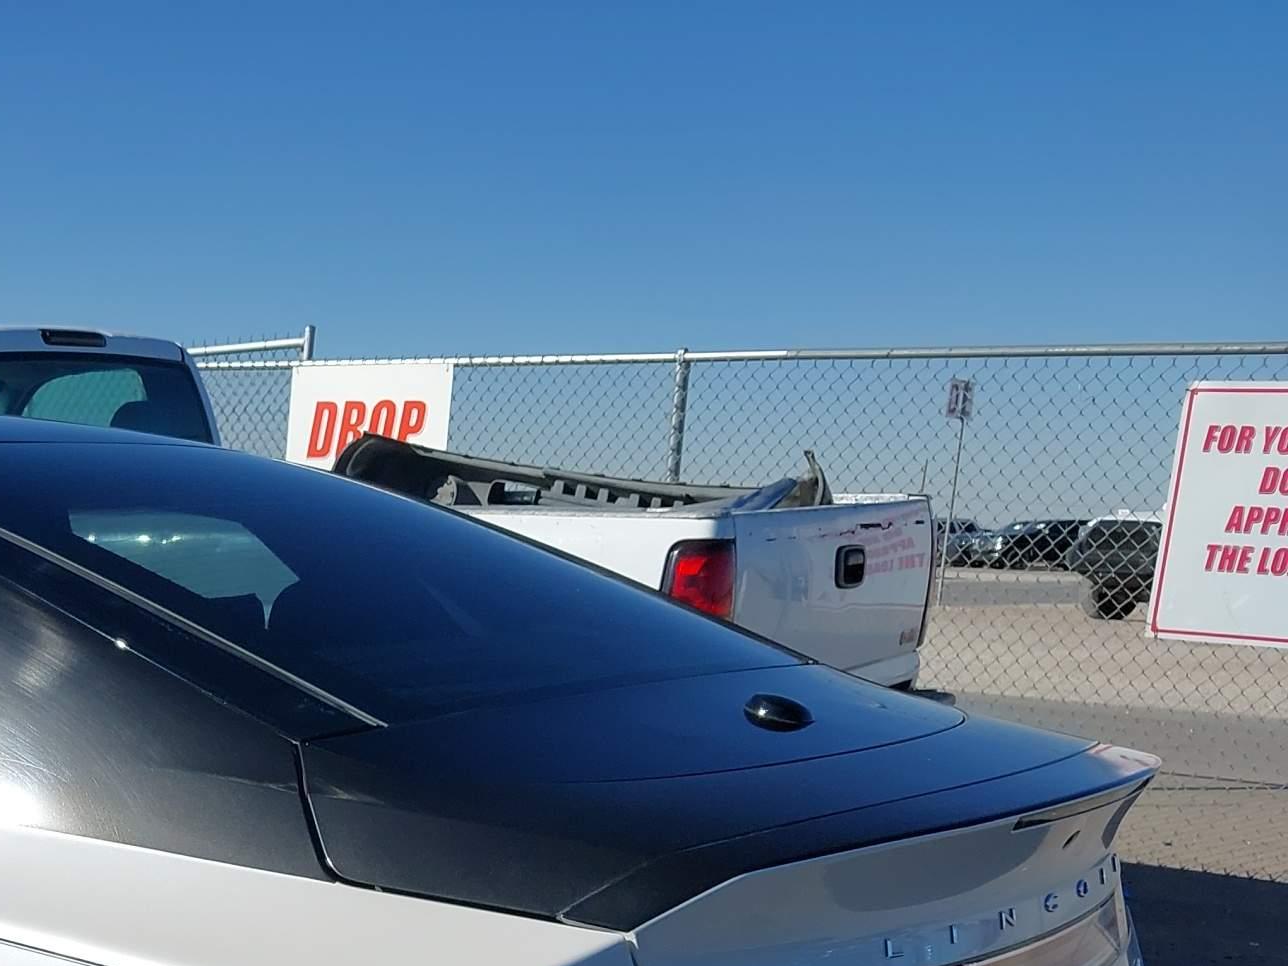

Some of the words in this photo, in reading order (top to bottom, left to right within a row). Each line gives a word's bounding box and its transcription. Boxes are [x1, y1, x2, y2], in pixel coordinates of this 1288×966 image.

[307, 400, 427, 458] DROP
[1202, 425, 1256, 454] FOR
[1205, 544, 1255, 574] THE
[1257, 547, 1288, 577] LO
